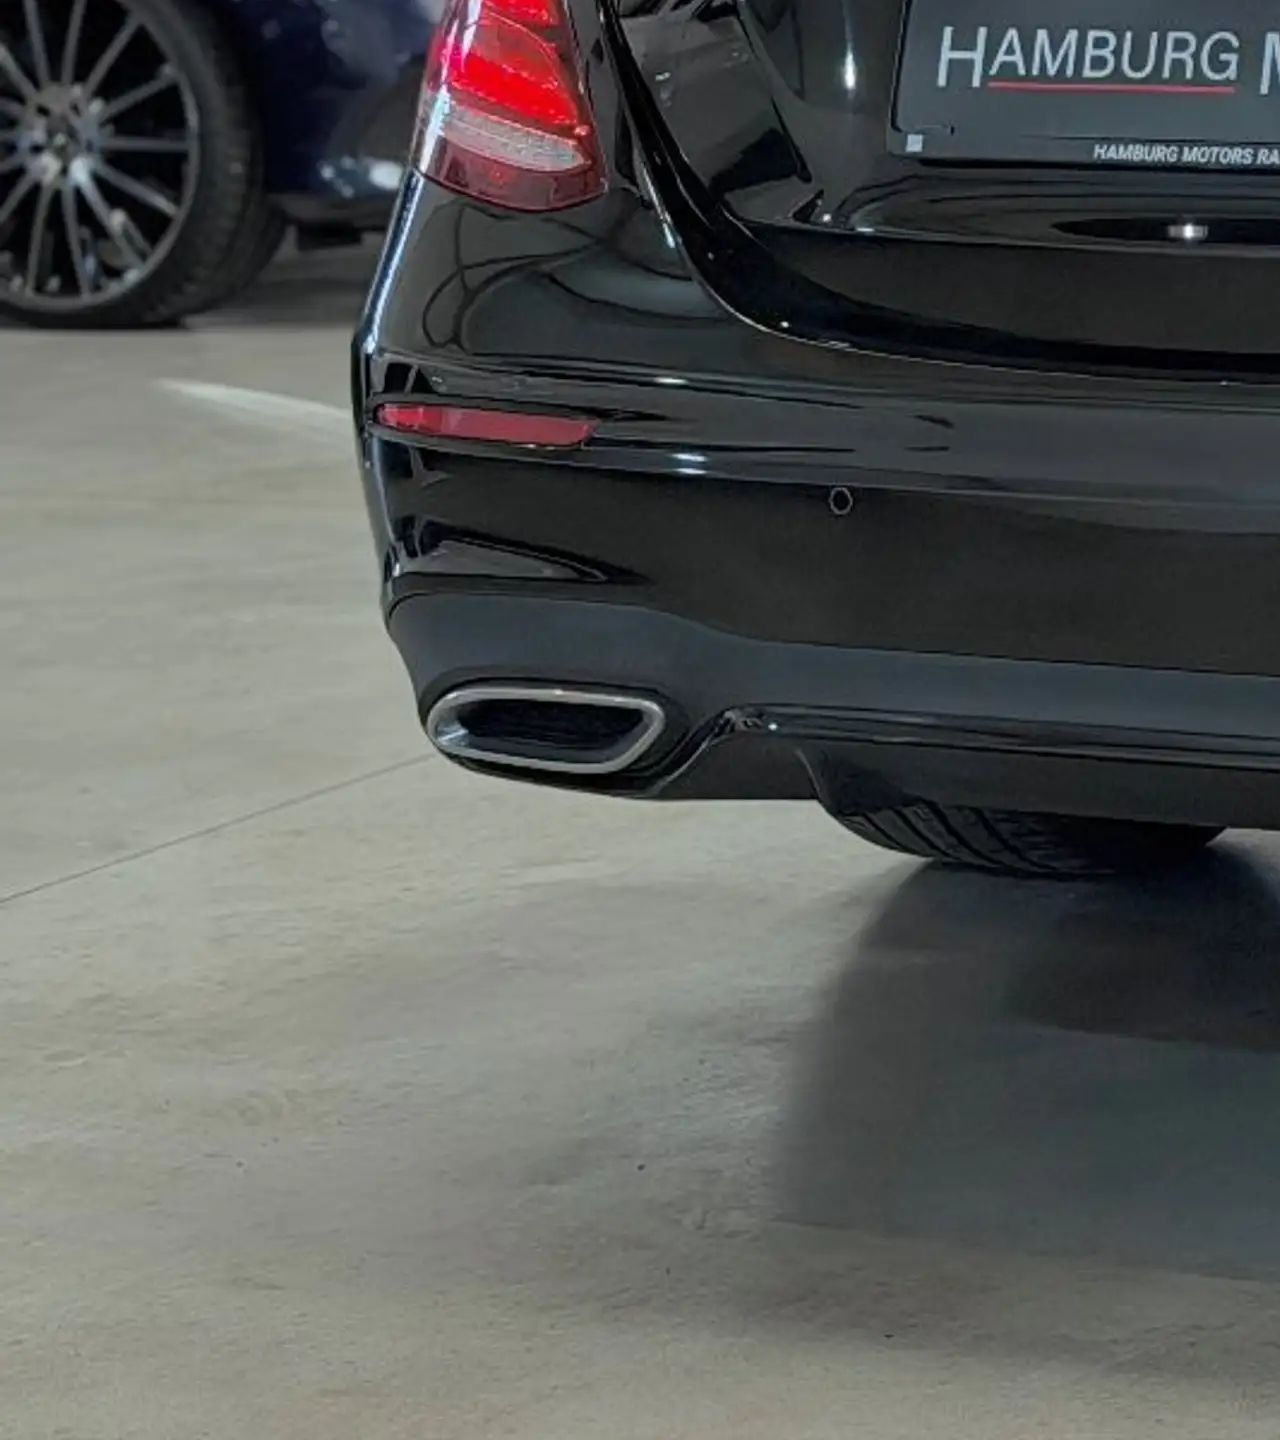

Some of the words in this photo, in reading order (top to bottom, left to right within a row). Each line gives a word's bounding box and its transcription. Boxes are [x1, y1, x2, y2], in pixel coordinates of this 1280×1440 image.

[937, 26, 1240, 88] HAMBURG
[1093, 144, 1180, 162] HAMBURG
[1182, 146, 1253, 164] MOTORS
[1256, 148, 1280, 165] RA
